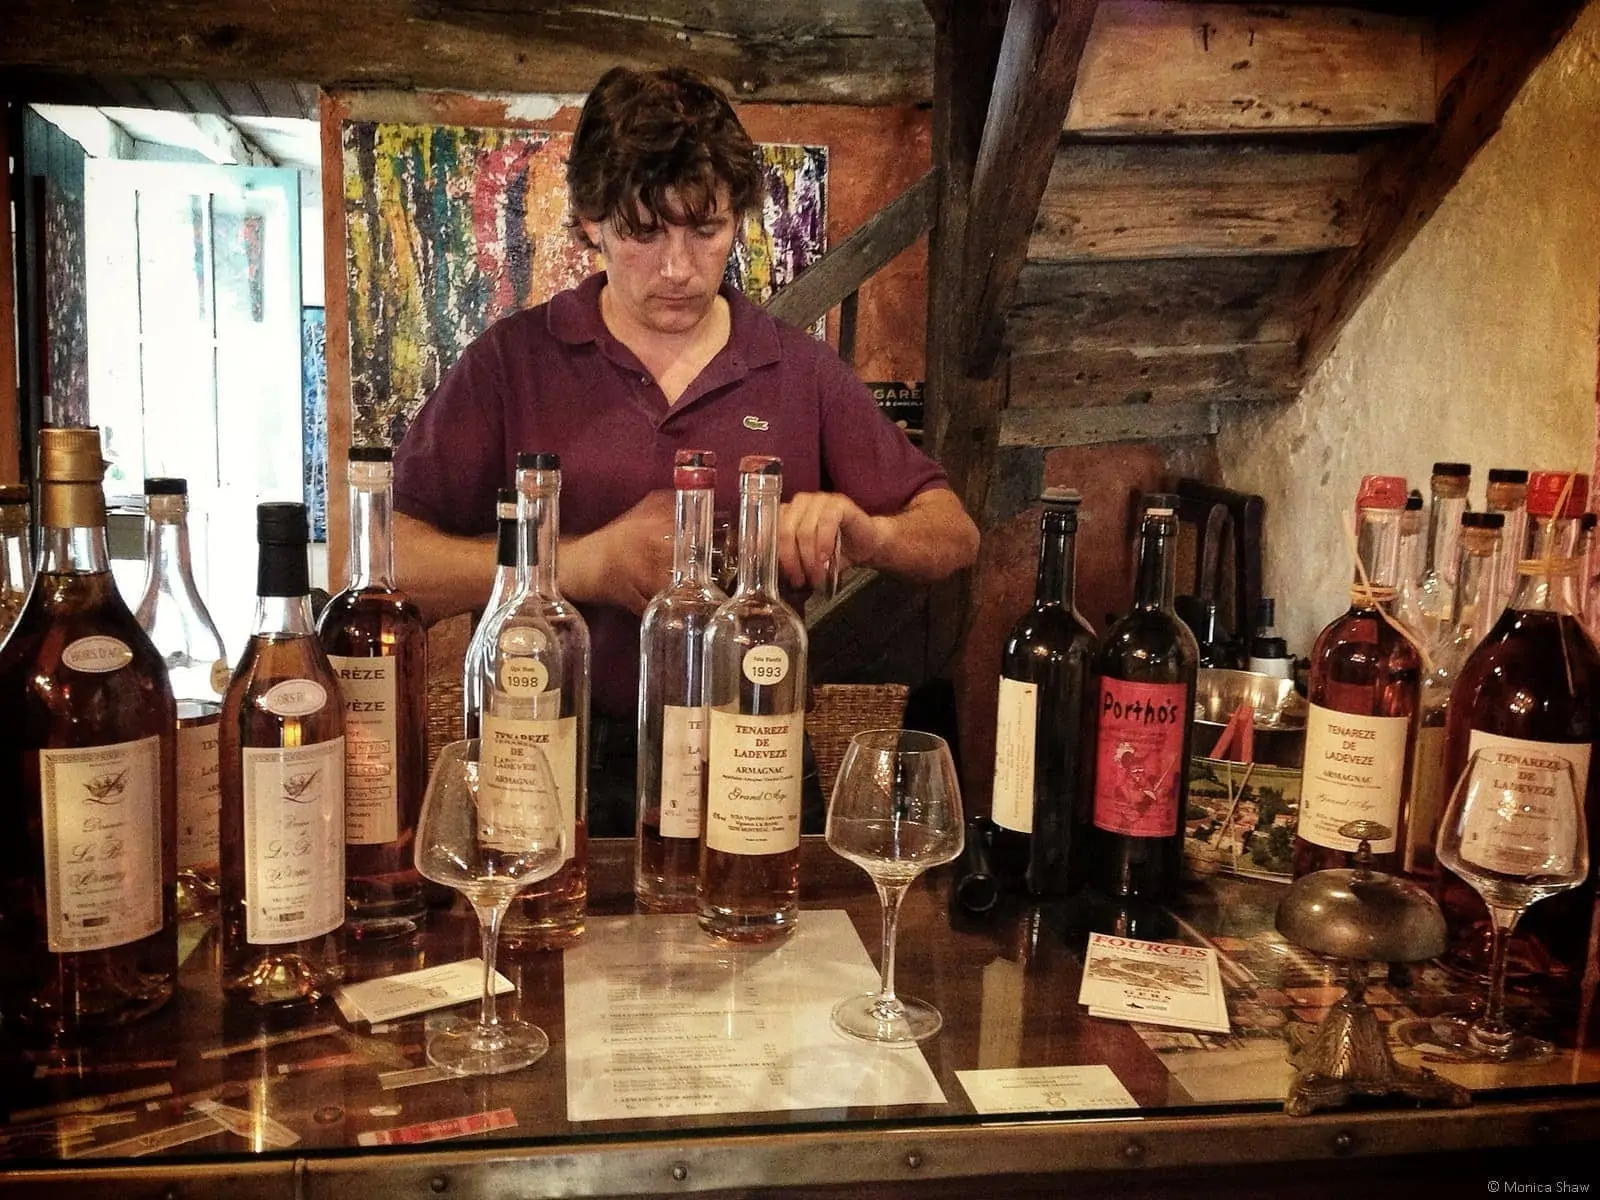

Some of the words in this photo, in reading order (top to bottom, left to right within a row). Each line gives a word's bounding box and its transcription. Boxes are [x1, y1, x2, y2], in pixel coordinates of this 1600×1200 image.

[752, 666, 781, 677] 1993
[508, 676, 539, 688] 1998
[1103, 691, 1178, 725] Portho's
[735, 724, 789, 735] TENAREZE
[1328, 724, 1377, 740] TENAREZE
[756, 738, 770, 747] DE
[1342, 740, 1356, 751] DE
[510, 747, 524, 757] DE
[734, 748, 788, 759] LADEVEZE
[1325, 750, 1375, 766] LADEVEZE
[1497, 752, 1561, 772] TENAREZE
[736, 766, 785, 775] ARMAGNAC
[1518, 770, 1537, 781] DE
